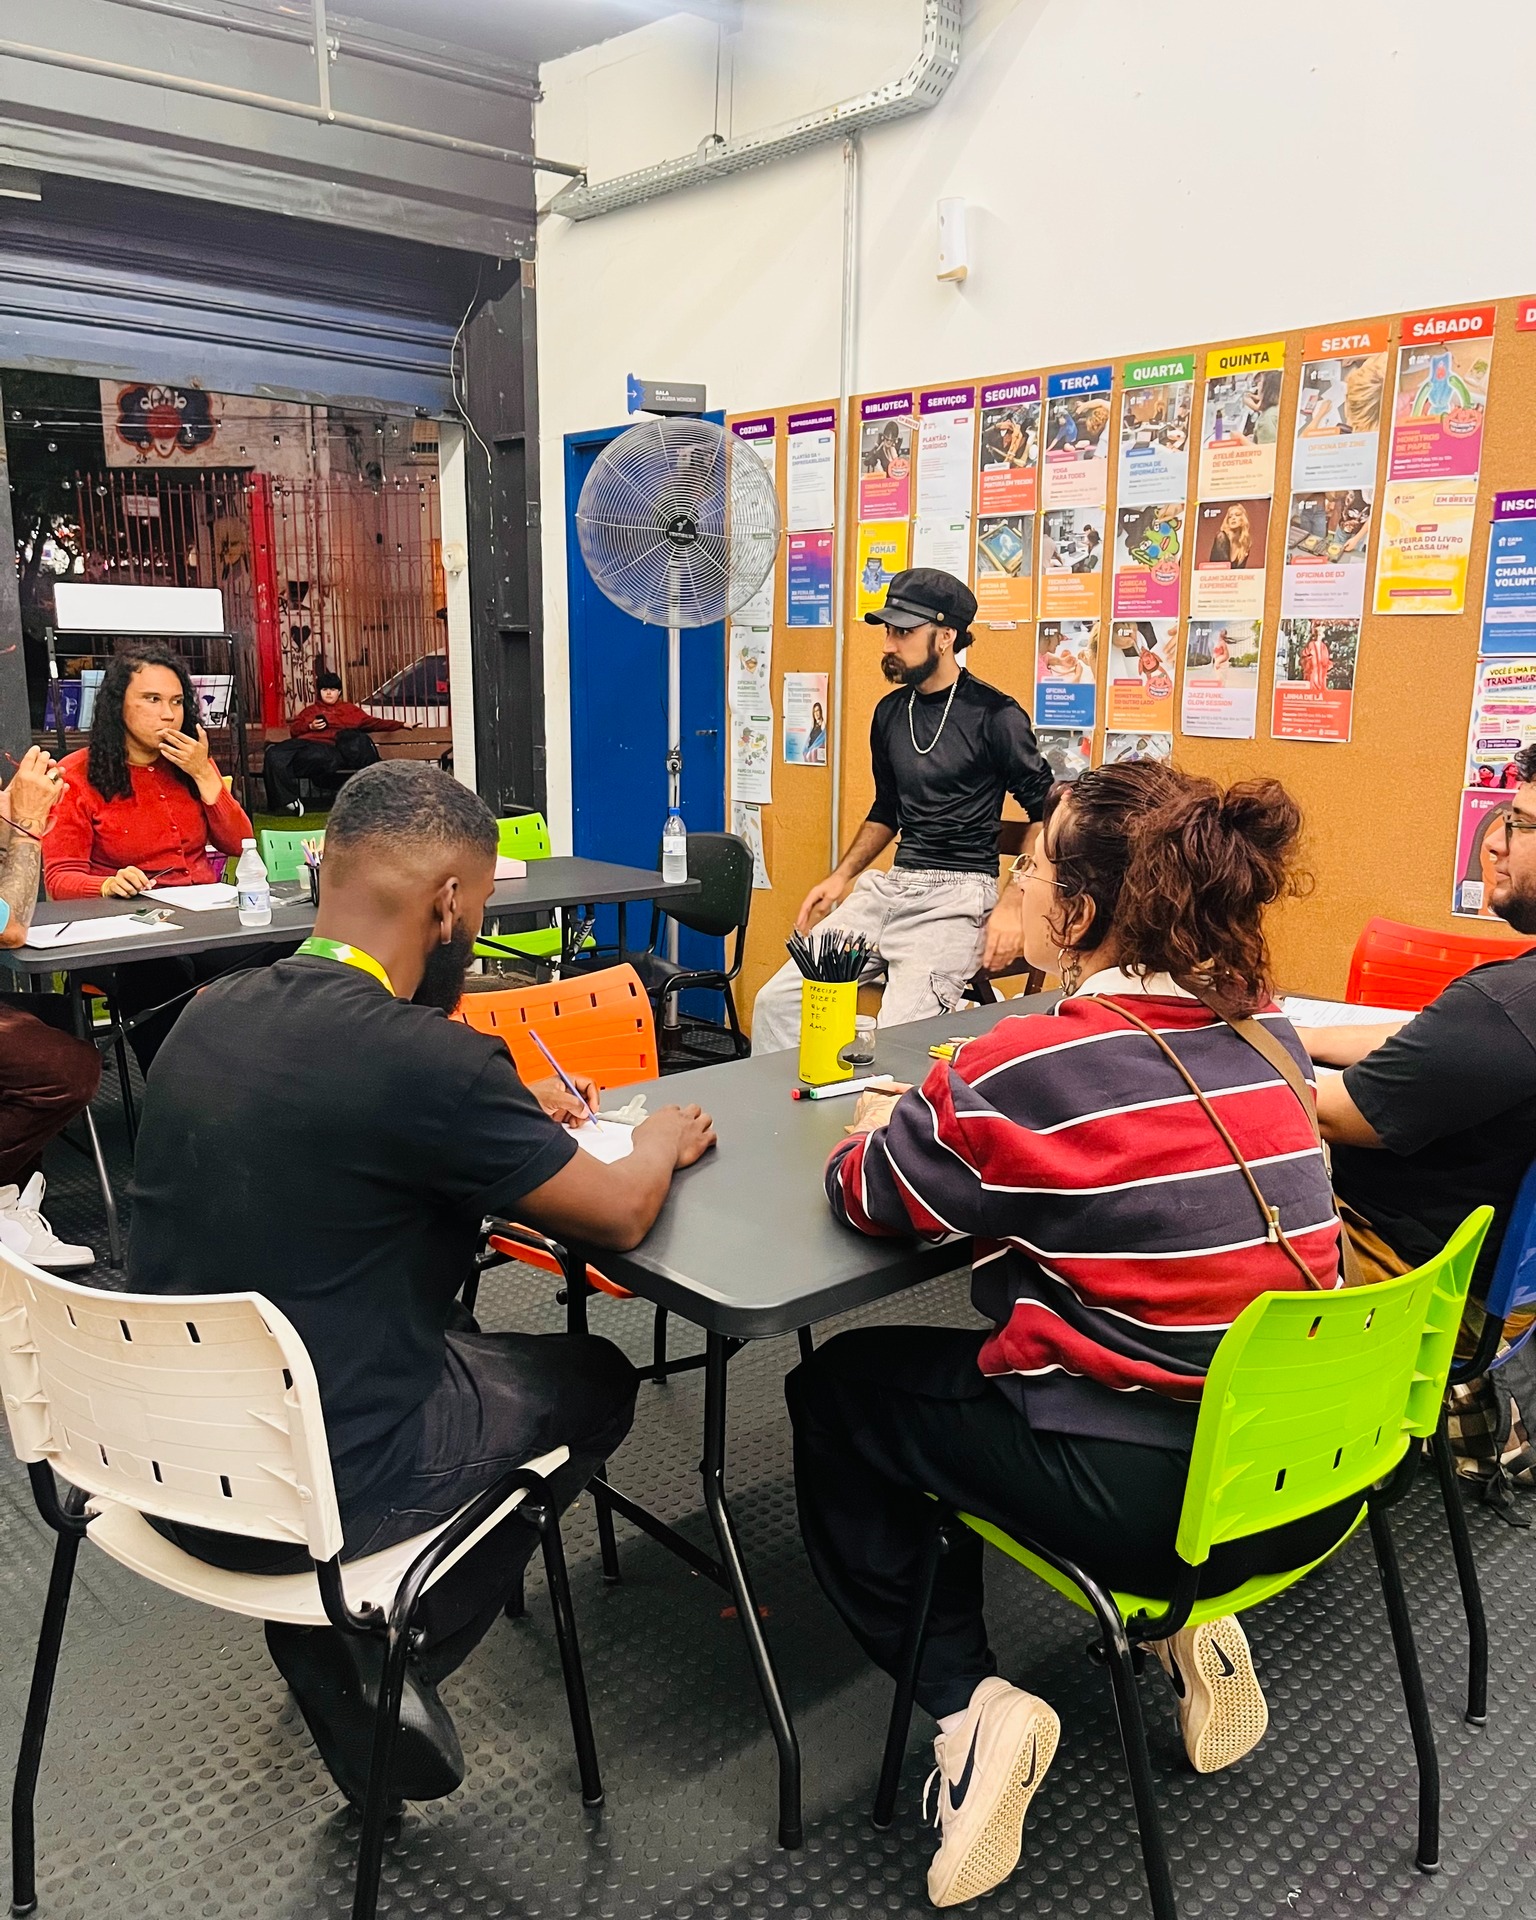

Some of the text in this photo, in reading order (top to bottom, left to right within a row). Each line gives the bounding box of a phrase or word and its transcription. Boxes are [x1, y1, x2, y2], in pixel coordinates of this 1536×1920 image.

[1526, 308, 1536, 323] D
[1413, 316, 1483, 337] SÁBADO
[1321, 333, 1371, 352] SEXTA
[1219, 351, 1270, 369] QUINTA
[1133, 362, 1184, 381] QUARTA
[1060, 374, 1099, 390] TERÇA
[985, 383, 1037, 403] SEGUNDA
[927, 394, 967, 407] SERVIÇOS
[865, 399, 909, 414] BIBLIOTECA
[739, 424, 768, 436] COZINHA
[922, 435, 947, 443] PLANTÃO
[1396, 433, 1440, 443] MONSTROS
[1407, 442, 1432, 451] PAPEL
[1235, 450, 1262, 458] ABERTO
[1212, 459, 1253, 468] DE COSTURA
[1129, 467, 1169, 476] INFORMÁTICA
[1501, 498, 1536, 512] INSC
[1398, 536, 1423, 545] FEIRA
[1437, 536, 1463, 544] LIVRO
[869, 545, 898, 554] POMAR
[1495, 566, 1536, 577] CHAMA
[1490, 667, 1506, 676] VOCÊ
[1487, 676, 1513, 687] TRANS
[810, 993, 837, 1003] DIZER
[811, 1003, 827, 1013] QUE
[811, 1012, 821, 1020] TE
[809, 1022, 827, 1032] AMO
